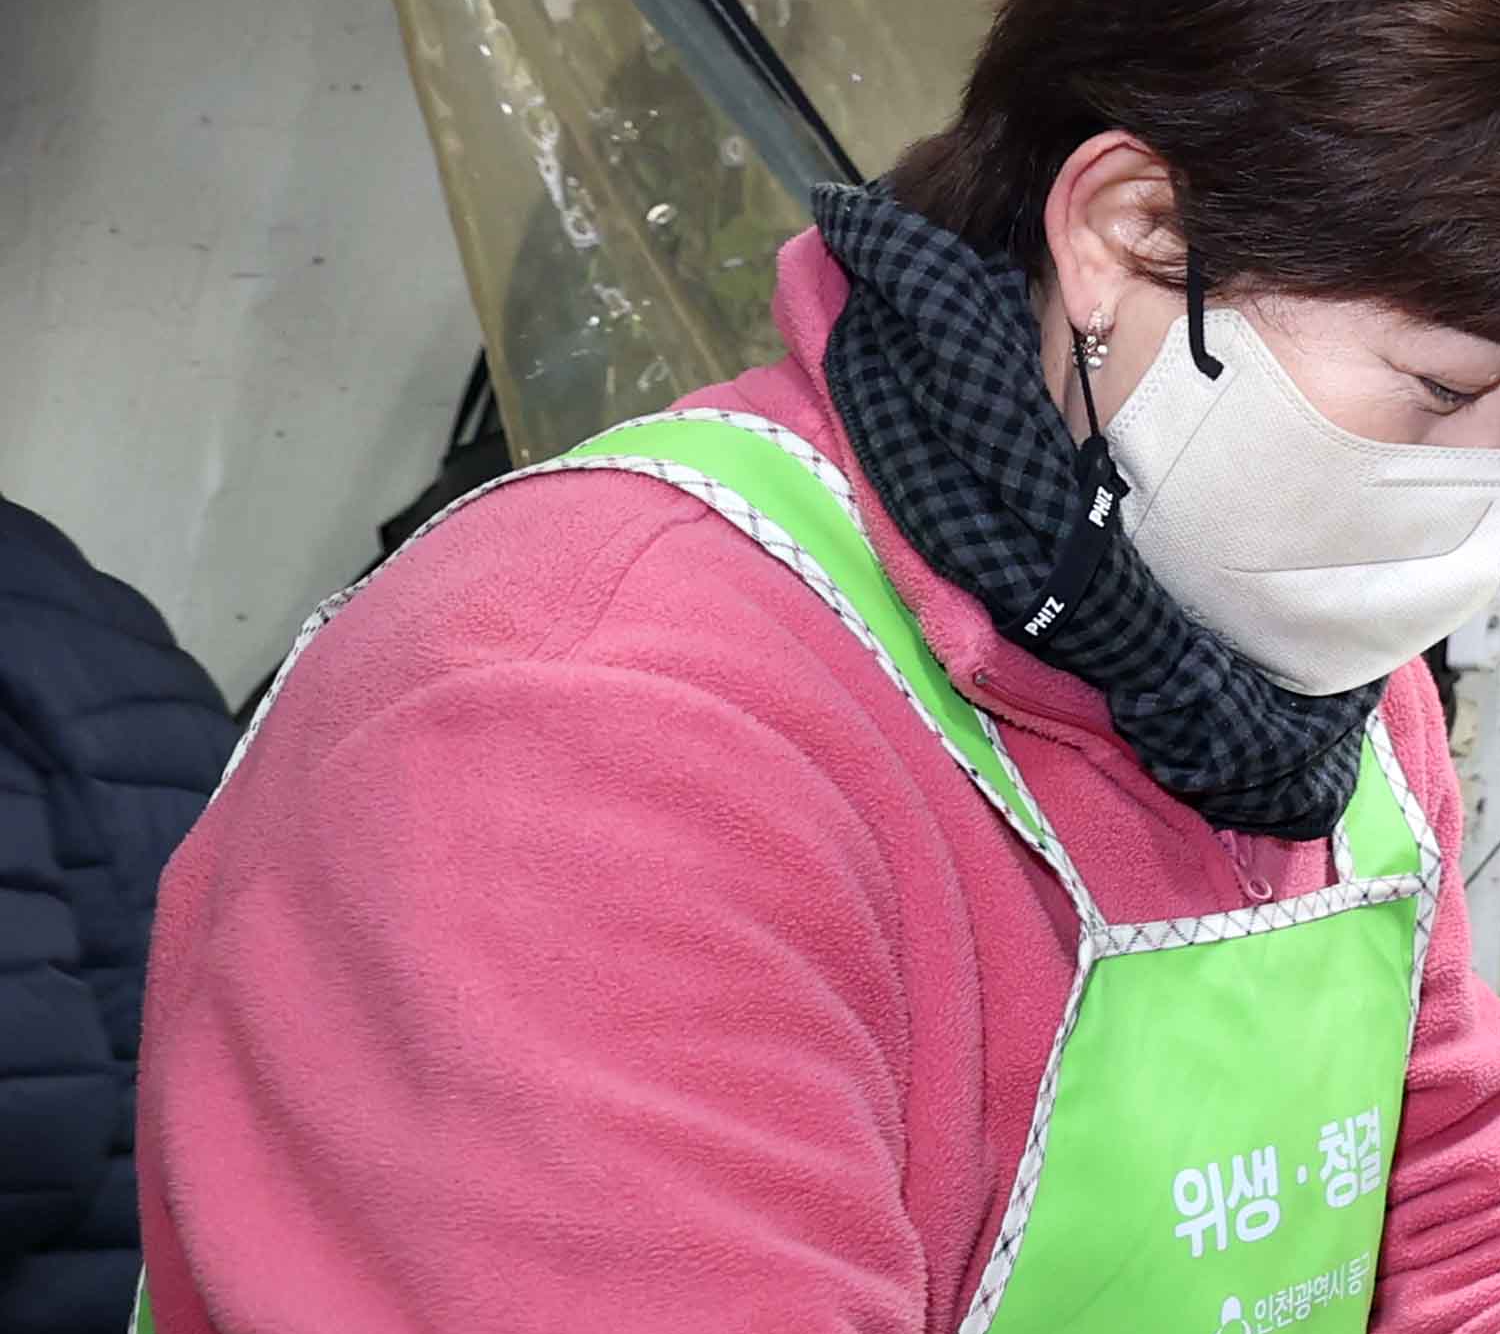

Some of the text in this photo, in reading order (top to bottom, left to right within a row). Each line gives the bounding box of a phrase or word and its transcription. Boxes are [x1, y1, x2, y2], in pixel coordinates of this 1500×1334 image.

[1088, 485, 1114, 528] PHIZ
[1023, 596, 1065, 637] PHIZ
[1172, 1106, 1382, 1258] 위생 청결
